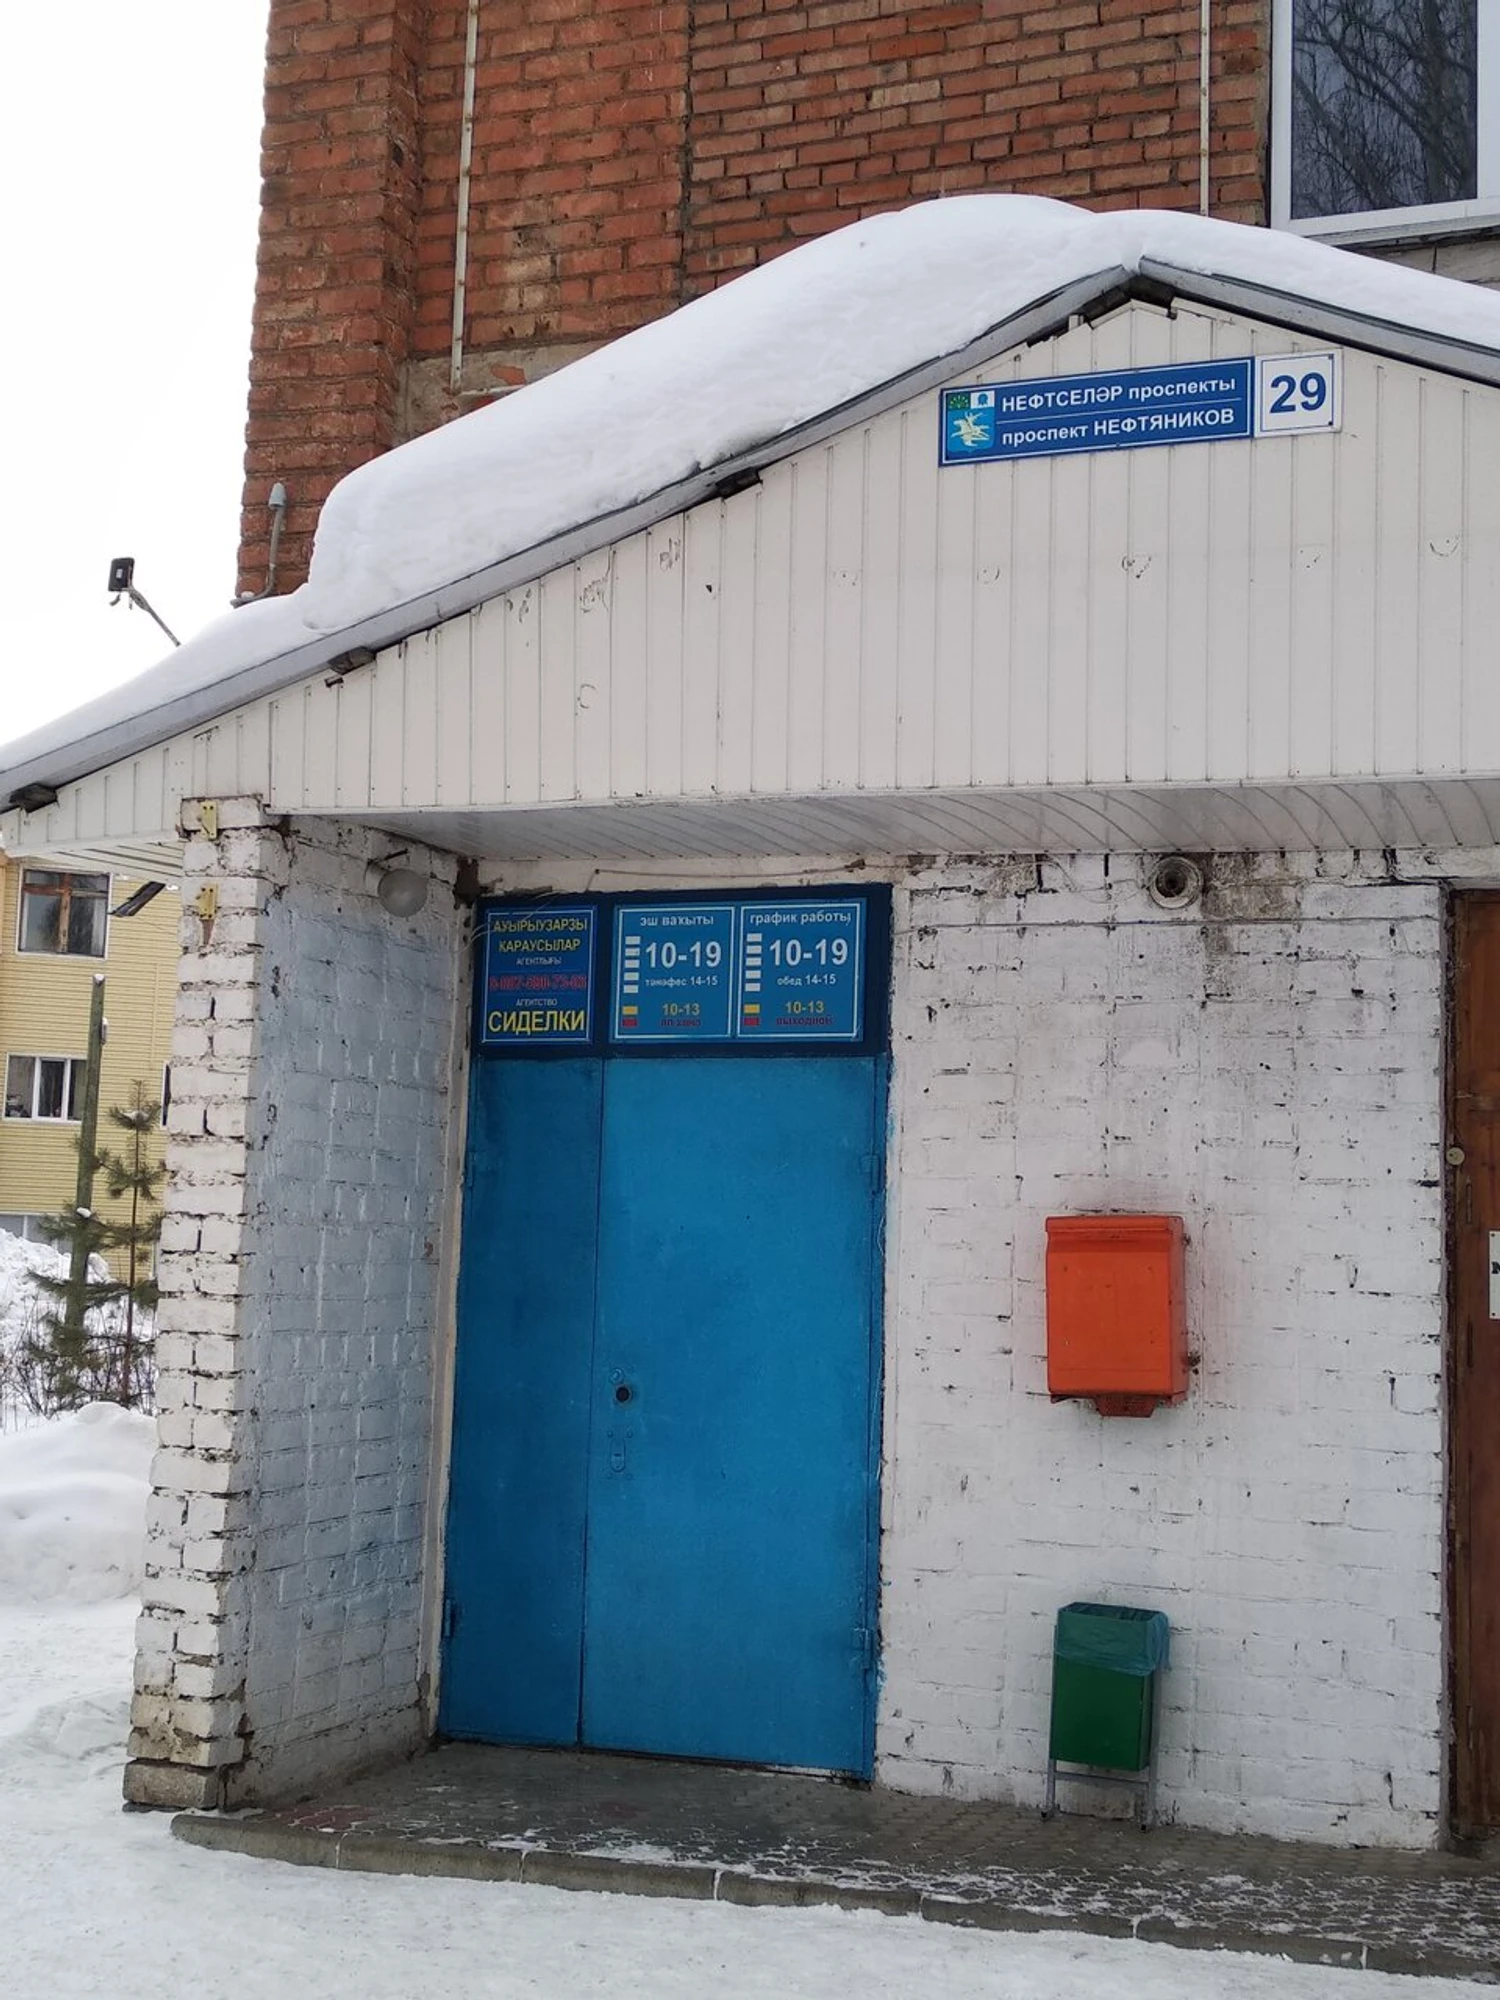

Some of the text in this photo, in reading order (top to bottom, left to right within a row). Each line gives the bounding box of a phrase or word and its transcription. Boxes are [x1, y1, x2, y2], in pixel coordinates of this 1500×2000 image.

[1002, 378, 1236, 413] НЕФТСЕЛӘР проспекты
[1269, 371, 1327, 414] 29
[1002, 407, 1235, 448] проспект НЕФТЯНИКОВ
[640, 916, 658, 927] эш
[750, 910, 851, 926] график работы
[645, 940, 722, 969] 10-19
[769, 938, 848, 967] 10-19
[690, 975, 718, 986] 14-15
[776, 973, 836, 987] обед 14-15
[662, 1003, 700, 1016] 10-13
[785, 1000, 825, 1014] 10-13
[487, 1010, 586, 1036] СИДЕЛКИ
